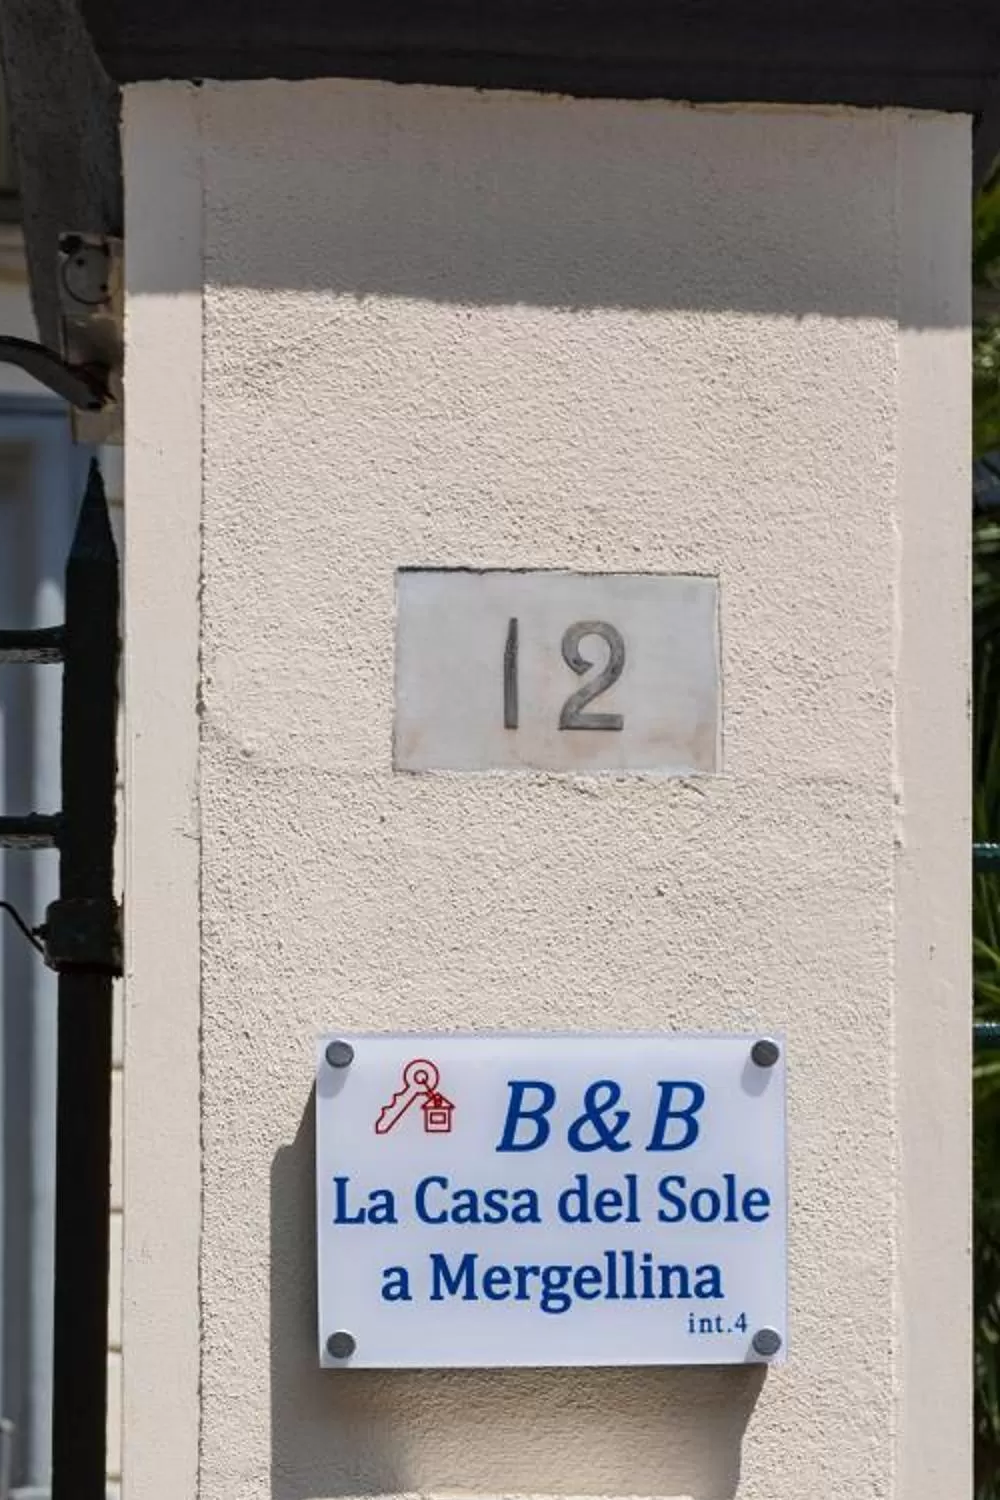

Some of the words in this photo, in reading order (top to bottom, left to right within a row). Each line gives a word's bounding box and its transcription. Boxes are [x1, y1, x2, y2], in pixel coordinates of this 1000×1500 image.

[503, 617, 625, 731] 12
[495, 1079, 705, 1153] B&B
[332, 1176, 398, 1225] La
[414, 1175, 541, 1223] Casa
[557, 1173, 641, 1223] del
[656, 1173, 771, 1222] Sole
[381, 1264, 413, 1302] a
[429, 1250, 725, 1314] Mergellina
[688, 1312, 749, 1334] int.4
